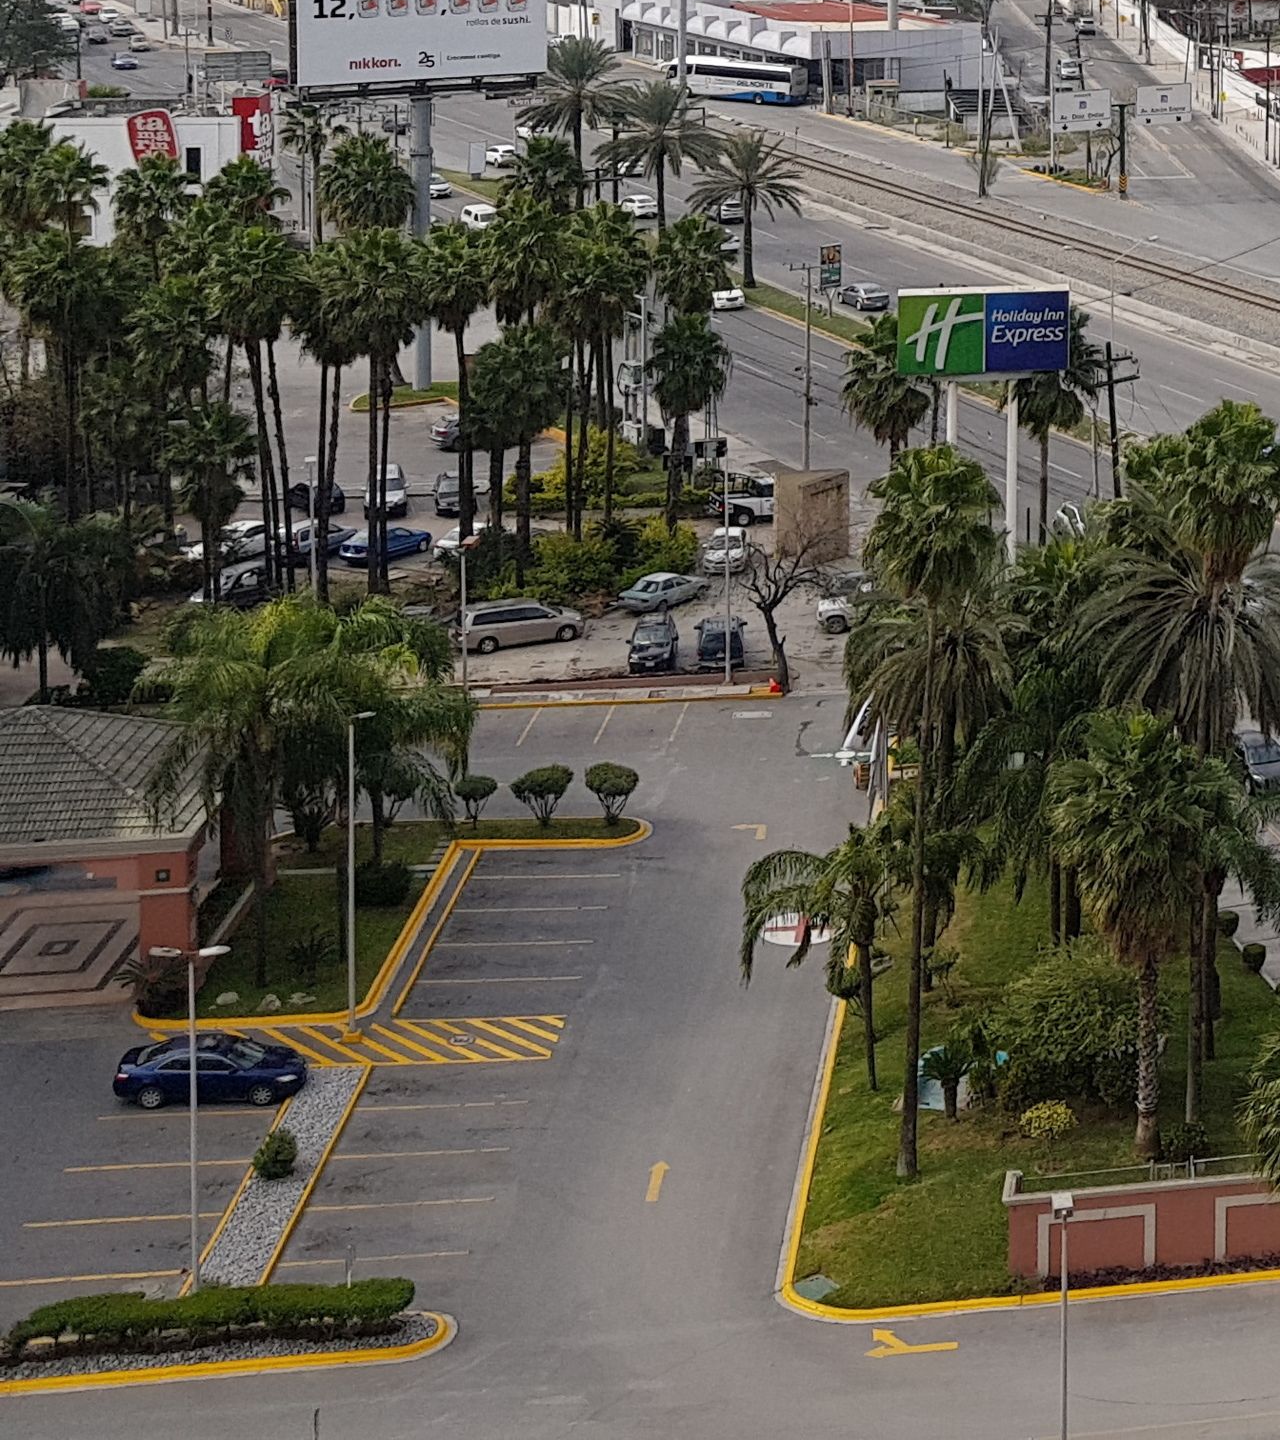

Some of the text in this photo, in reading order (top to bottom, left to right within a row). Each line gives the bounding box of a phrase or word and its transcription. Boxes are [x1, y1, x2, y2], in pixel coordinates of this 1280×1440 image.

[490, 18, 501, 26] de
[418, 50, 435, 68] 25
[134, 115, 167, 131] ta
[247, 109, 272, 136] ta
[991, 307, 1065, 324] Holiday Inn
[991, 325, 1066, 347] Express
